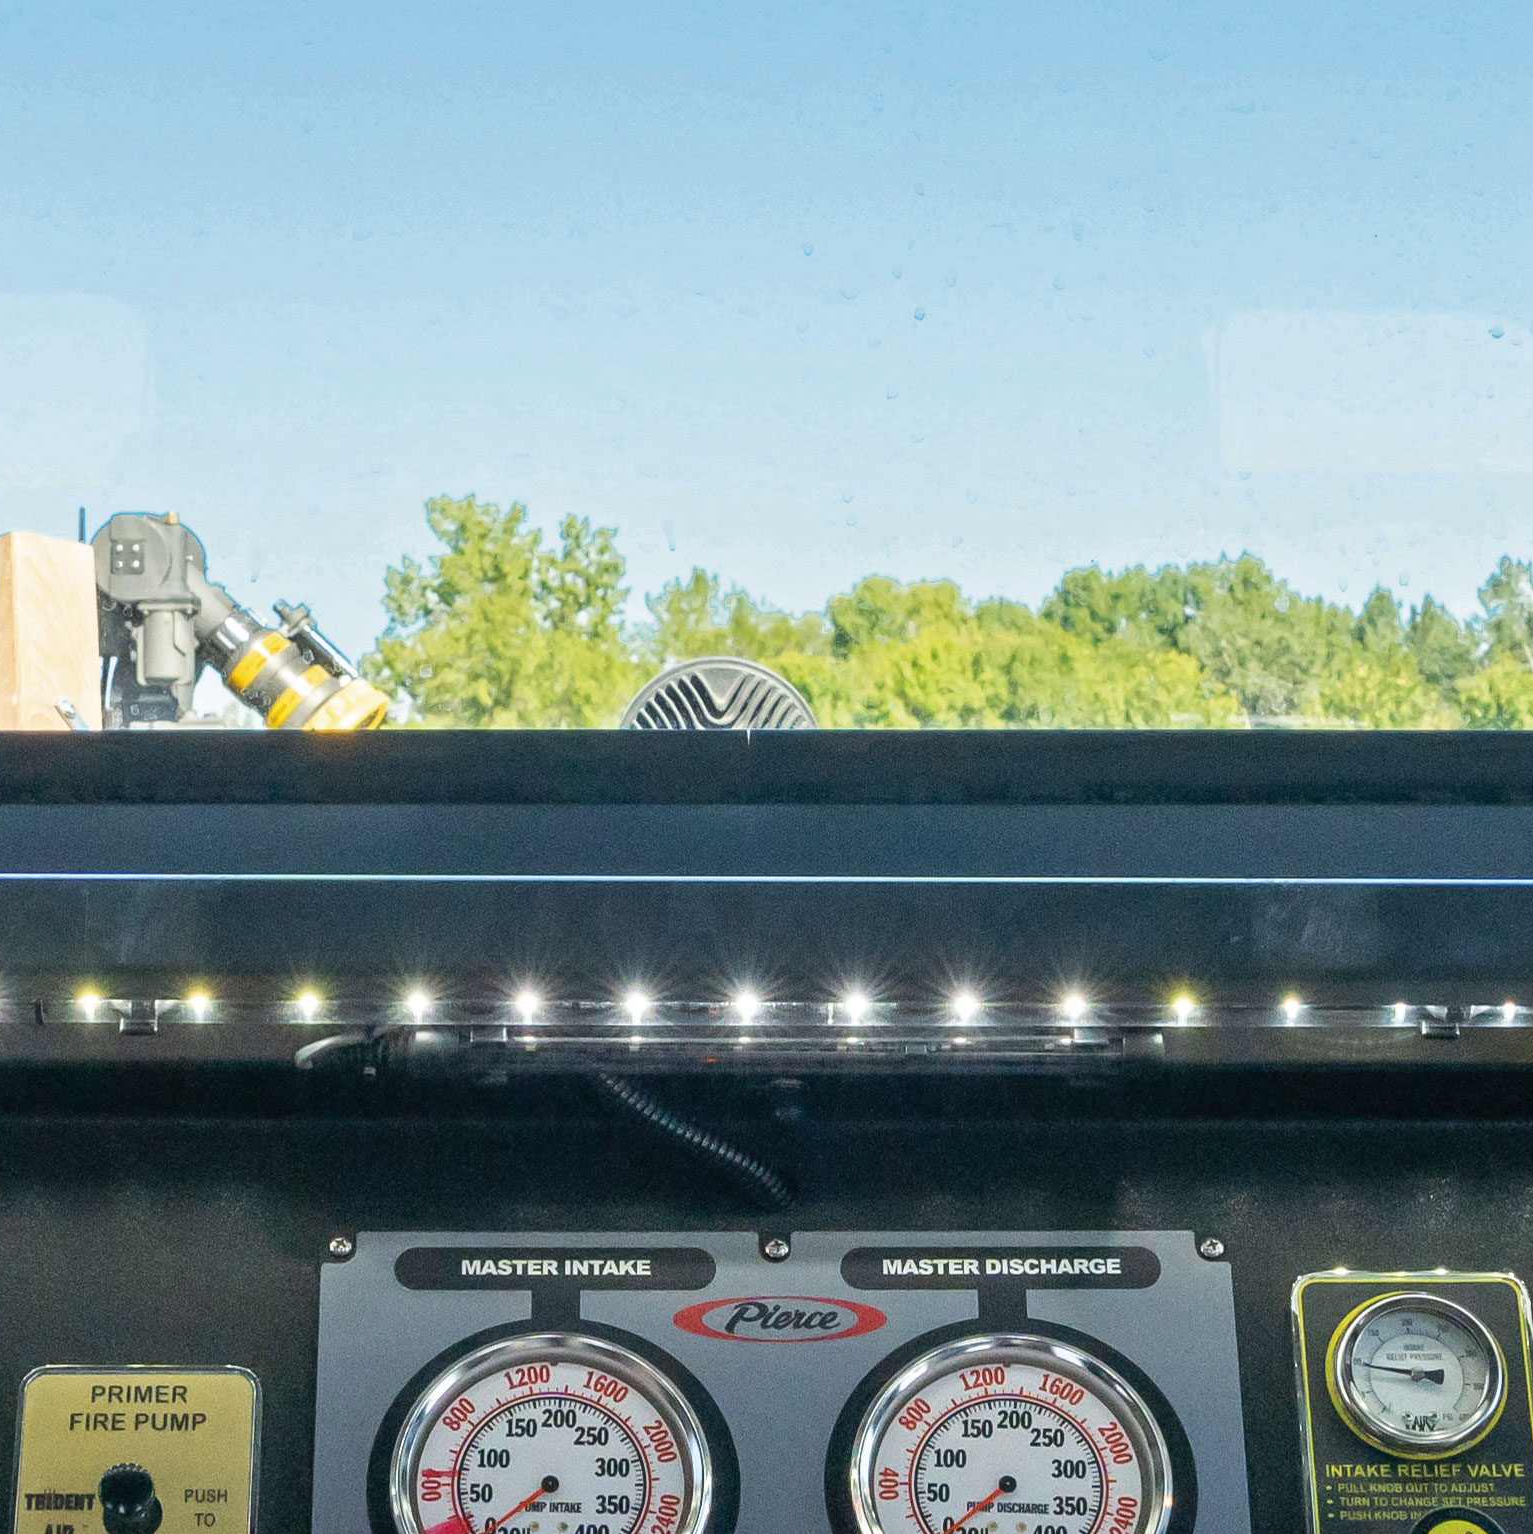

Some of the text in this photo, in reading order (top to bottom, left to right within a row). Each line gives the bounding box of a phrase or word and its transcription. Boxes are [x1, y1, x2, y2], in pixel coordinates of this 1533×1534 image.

[461, 1259, 651, 1276] MASTER INTAKE
[882, 1258, 1122, 1275] MASTER DISCHARGE
[724, 1301, 842, 1334] Pierce
[504, 1365, 552, 1390] 1200
[582, 1371, 629, 1403] 1600
[959, 1366, 1006, 1392] 1200
[91, 1385, 188, 1404] PRIMER
[1039, 1373, 1085, 1406] 1600
[69, 1413, 207, 1431] FIRE PUMP
[442, 1398, 476, 1432] 800
[541, 1410, 577, 1429] 200
[898, 1398, 931, 1431] 800
[997, 1410, 1032, 1430] 200
[505, 1419, 537, 1438] 150
[573, 1427, 609, 1446] 250
[961, 1419, 993, 1438] 150
[1030, 1428, 1065, 1447] 250
[643, 1420, 677, 1464] 2000
[1098, 1421, 1133, 1466] 2000
[477, 1449, 510, 1468] 100
[594, 1458, 630, 1478] 300
[933, 1449, 966, 1468] 100
[1051, 1460, 1086, 1479] 300
[1325, 1463, 1525, 1477] INTAKE RELIEF VALVE
[469, 1484, 493, 1502] 50
[878, 1466, 900, 1501] 400
[1337, 1483, 1366, 1492] PULL
[1370, 1483, 1402, 1492] KNOB
[1405, 1483, 1429, 1492] OUT
[1432, 1483, 1447, 1492] TO
[24, 1490, 97, 1511] TRIDENT
[184, 1489, 228, 1503] PUSH
[927, 1484, 950, 1503] 50
[1339, 1497, 1526, 1507] TURN TO CHANGE SET PRESSURE
[549, 1502, 582, 1514] INTAKE
[596, 1495, 630, 1514] 350
[996, 1501, 1049, 1515] DISCHARGE
[1053, 1497, 1088, 1516] 350
[194, 1513, 216, 1527] TO
[1340, 1511, 1372, 1520] PUSH
[1375, 1511, 1408, 1520] KNOB
